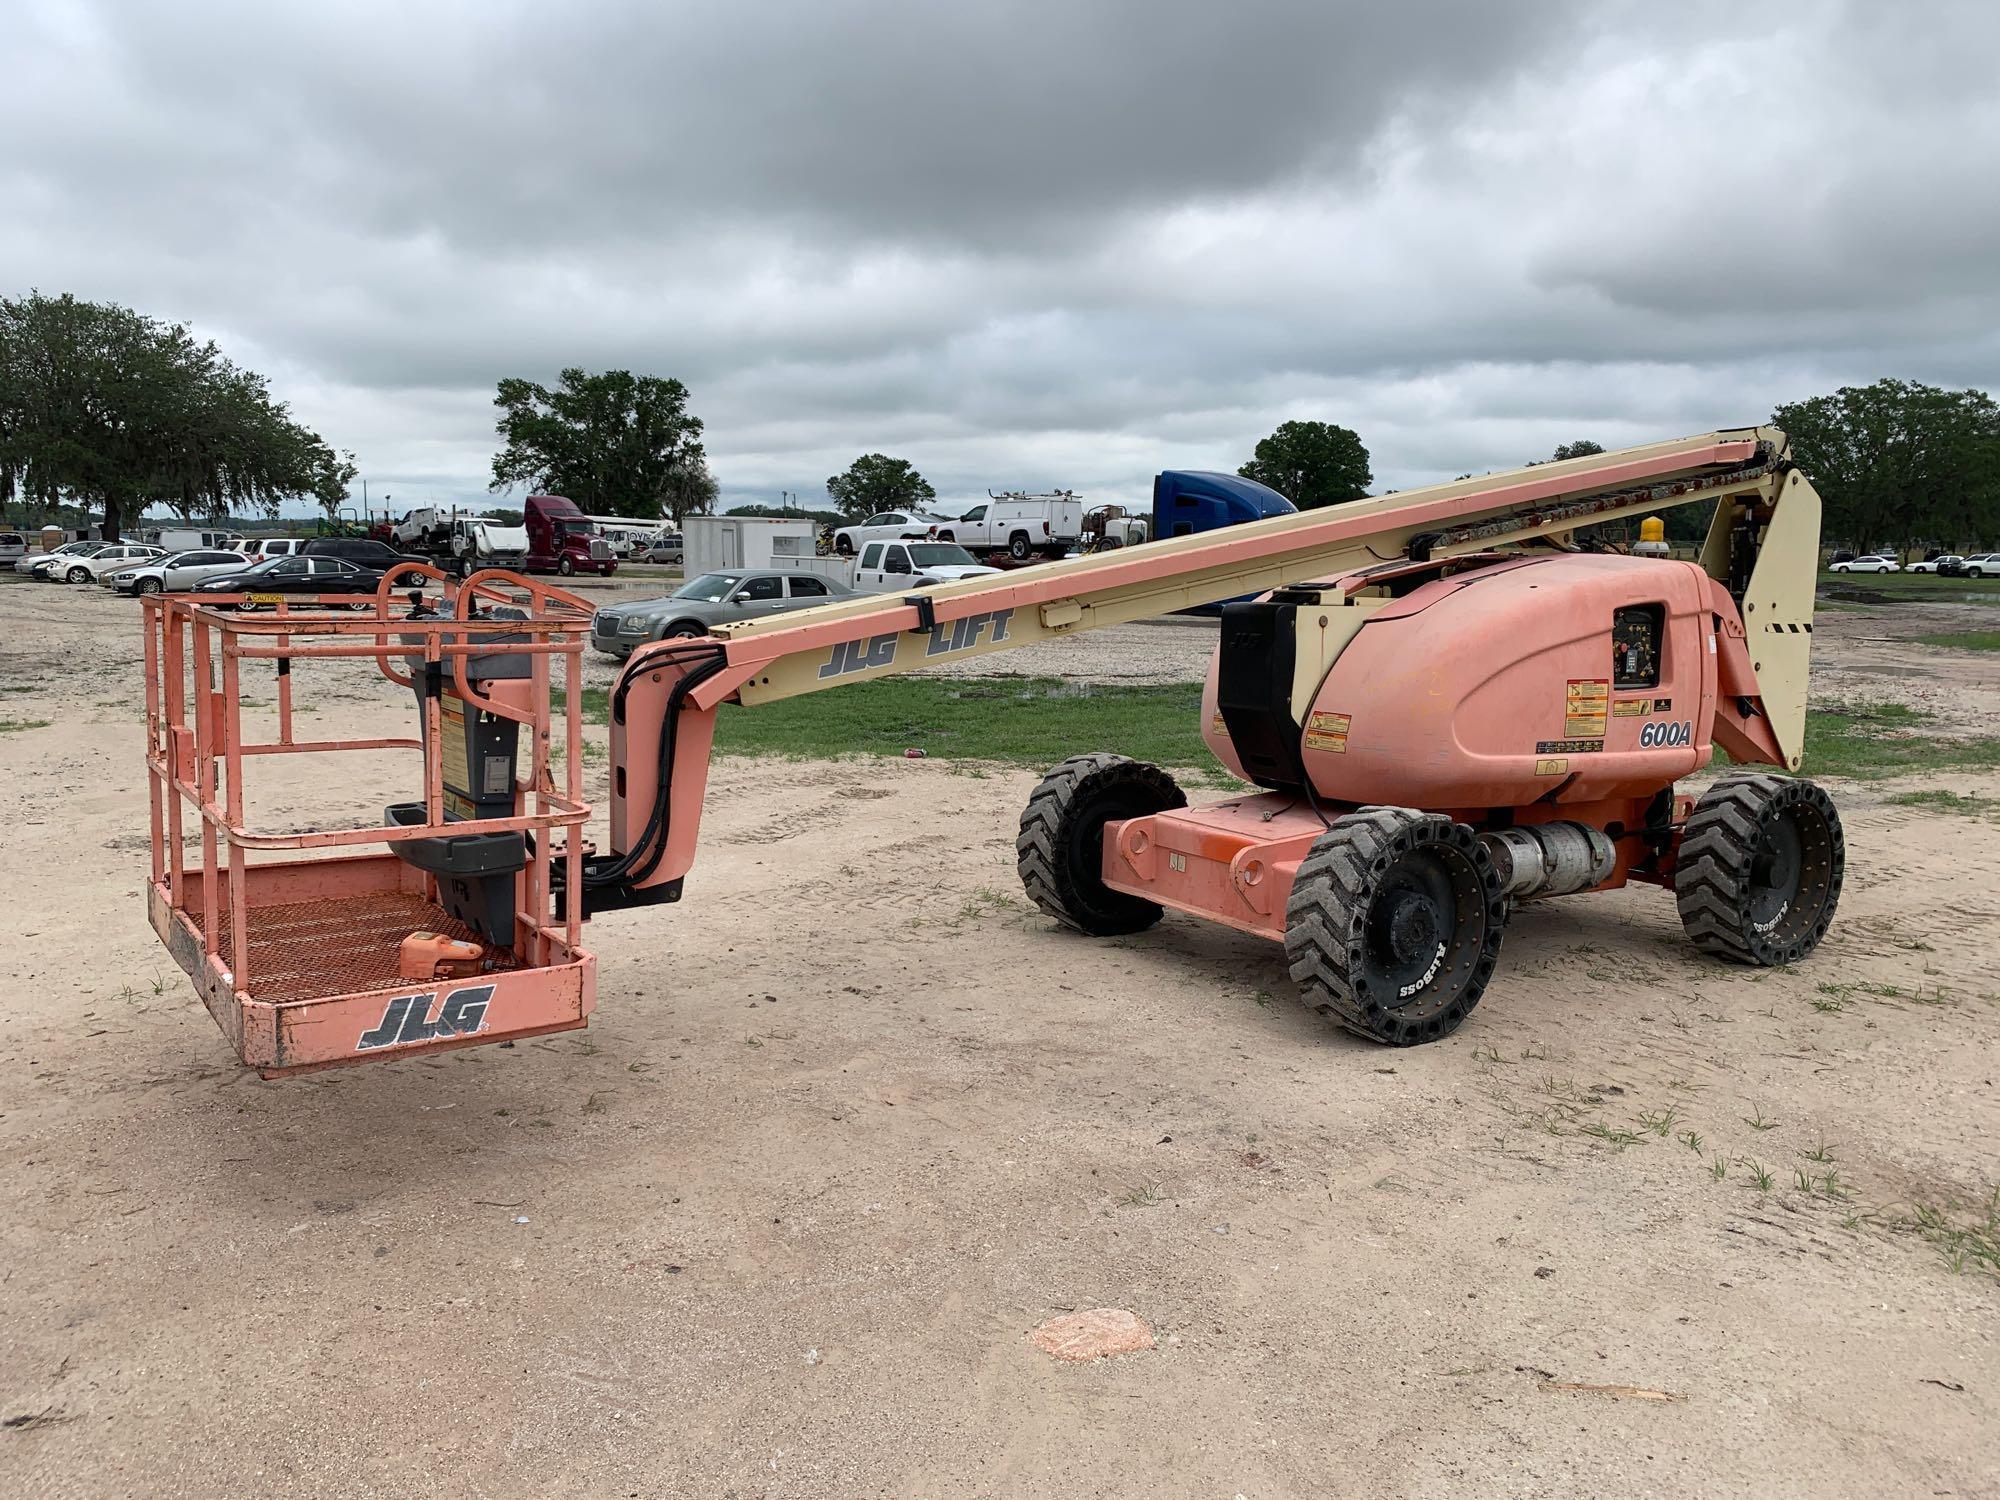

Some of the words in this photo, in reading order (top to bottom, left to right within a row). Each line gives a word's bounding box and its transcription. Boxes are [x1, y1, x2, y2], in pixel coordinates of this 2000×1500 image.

[818, 632, 899, 680] JLG
[925, 608, 1015, 658] LIFT
[1640, 720, 1692, 749] 600A
[355, 983, 498, 1051] JLG
